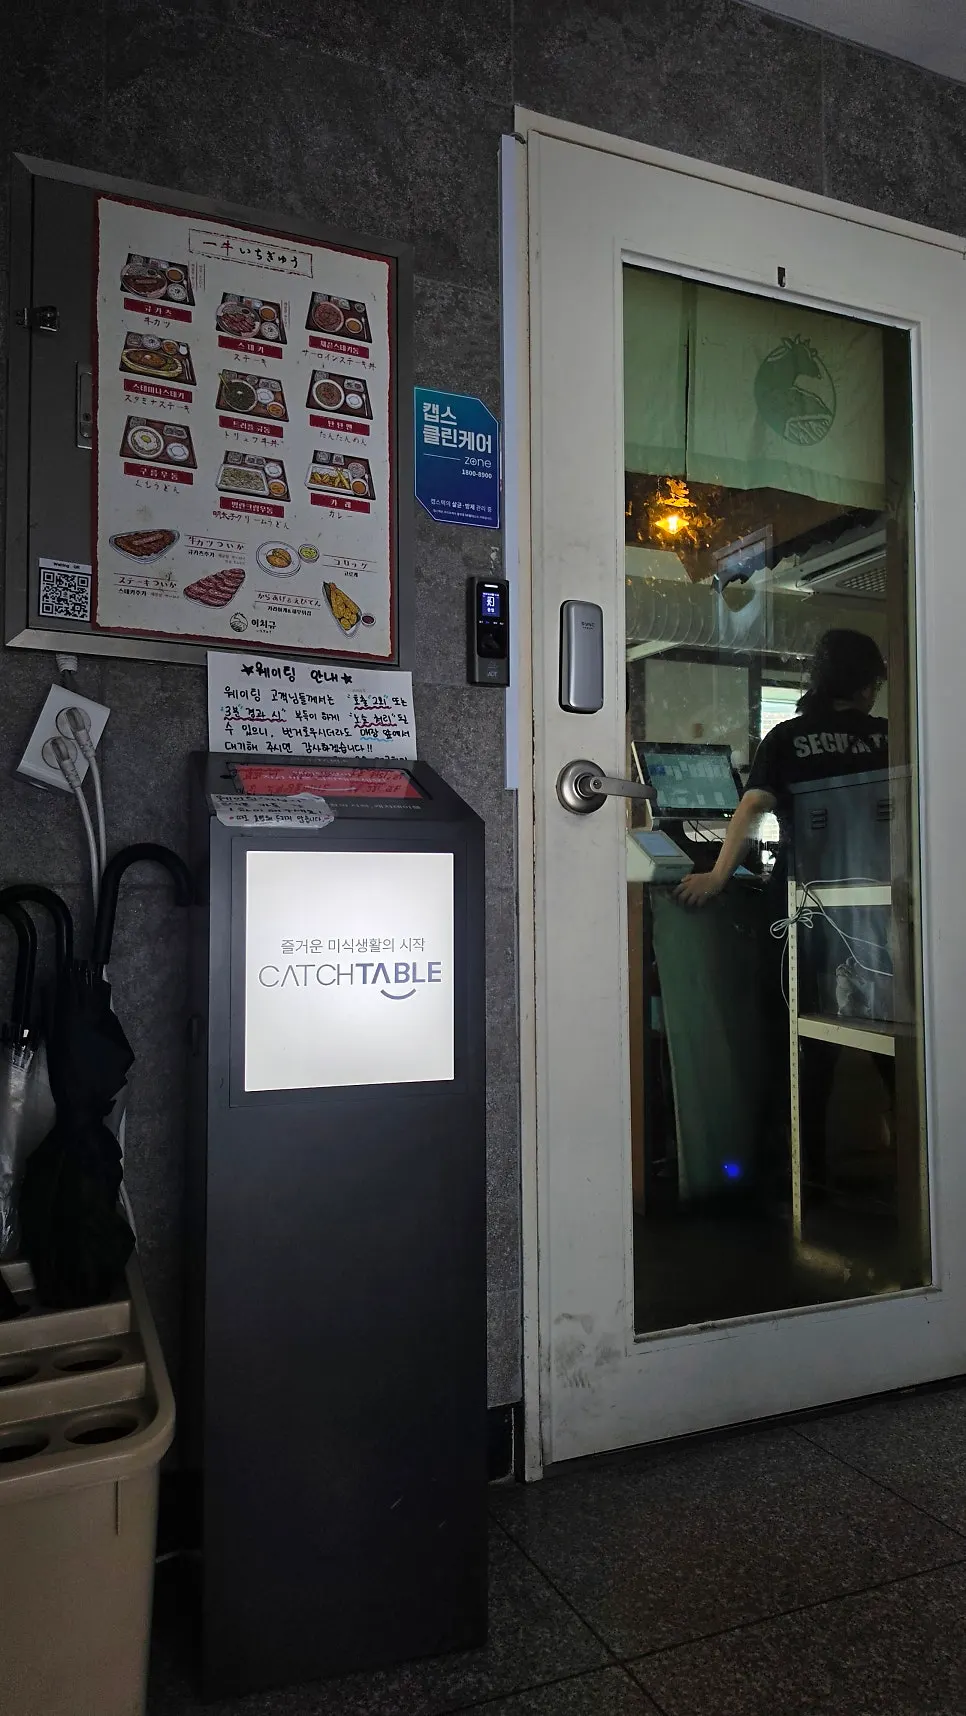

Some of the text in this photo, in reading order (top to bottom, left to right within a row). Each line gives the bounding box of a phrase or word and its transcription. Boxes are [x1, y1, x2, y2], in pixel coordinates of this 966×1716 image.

[422, 402, 457, 425] 캡스
[422, 424, 492, 453] 클린케어
[464, 457, 492, 468] zone
[251, 618, 276, 630] 이치규
[254, 661, 338, 684] 웨이팅 안내
[223, 686, 261, 702] 웨이팅
[271, 688, 335, 706] 고객님들께서는
[224, 721, 234, 736] 수
[282, 726, 352, 739] 번거로우시더라도
[224, 741, 258, 751] 대기해
[266, 741, 291, 752] 주시면
[280, 937, 426, 954] 즐거운 미식생활의 시작
[258, 961, 442, 988] CATCHTABLE
